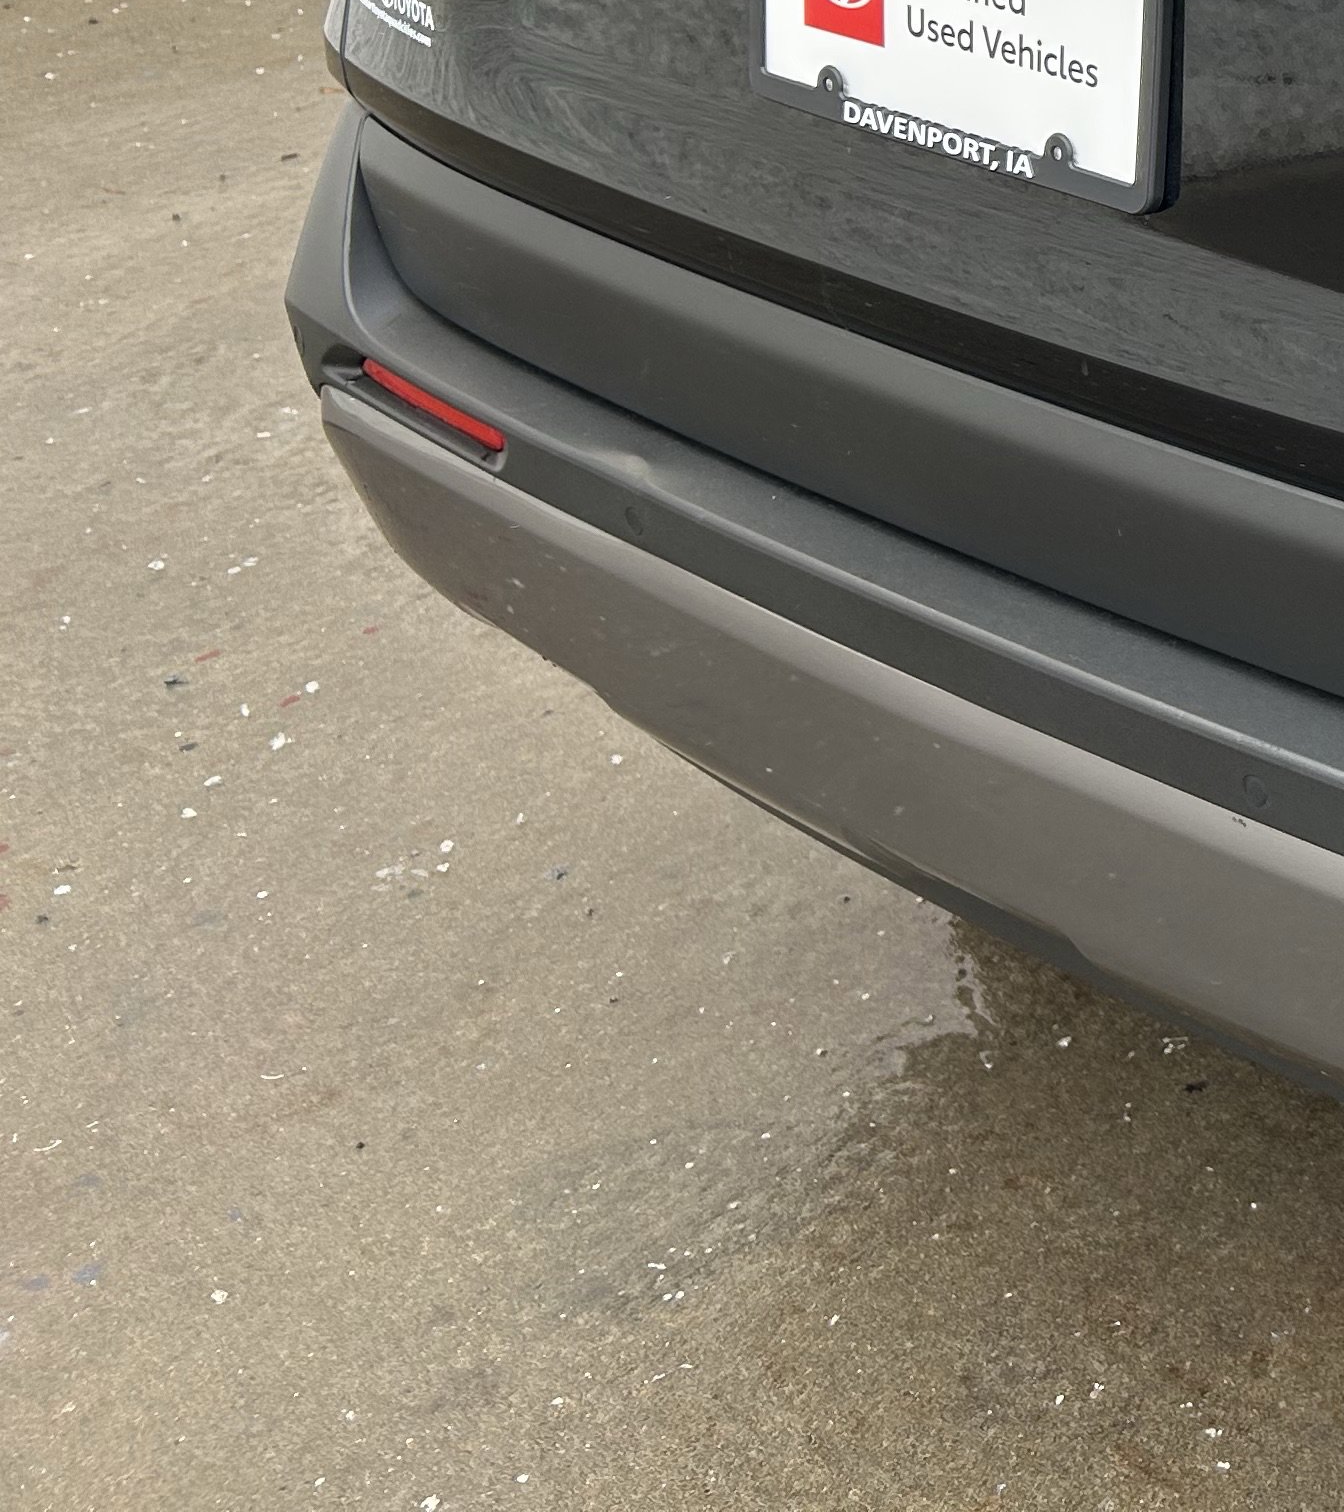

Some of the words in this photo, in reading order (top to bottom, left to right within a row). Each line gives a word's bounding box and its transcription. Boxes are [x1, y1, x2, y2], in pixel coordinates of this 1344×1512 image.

[906, 4, 975, 53] Used
[982, 25, 1099, 88] Vehicles
[842, 99, 1000, 172] DAVENPORT,
[1005, 149, 1035, 179] IA
